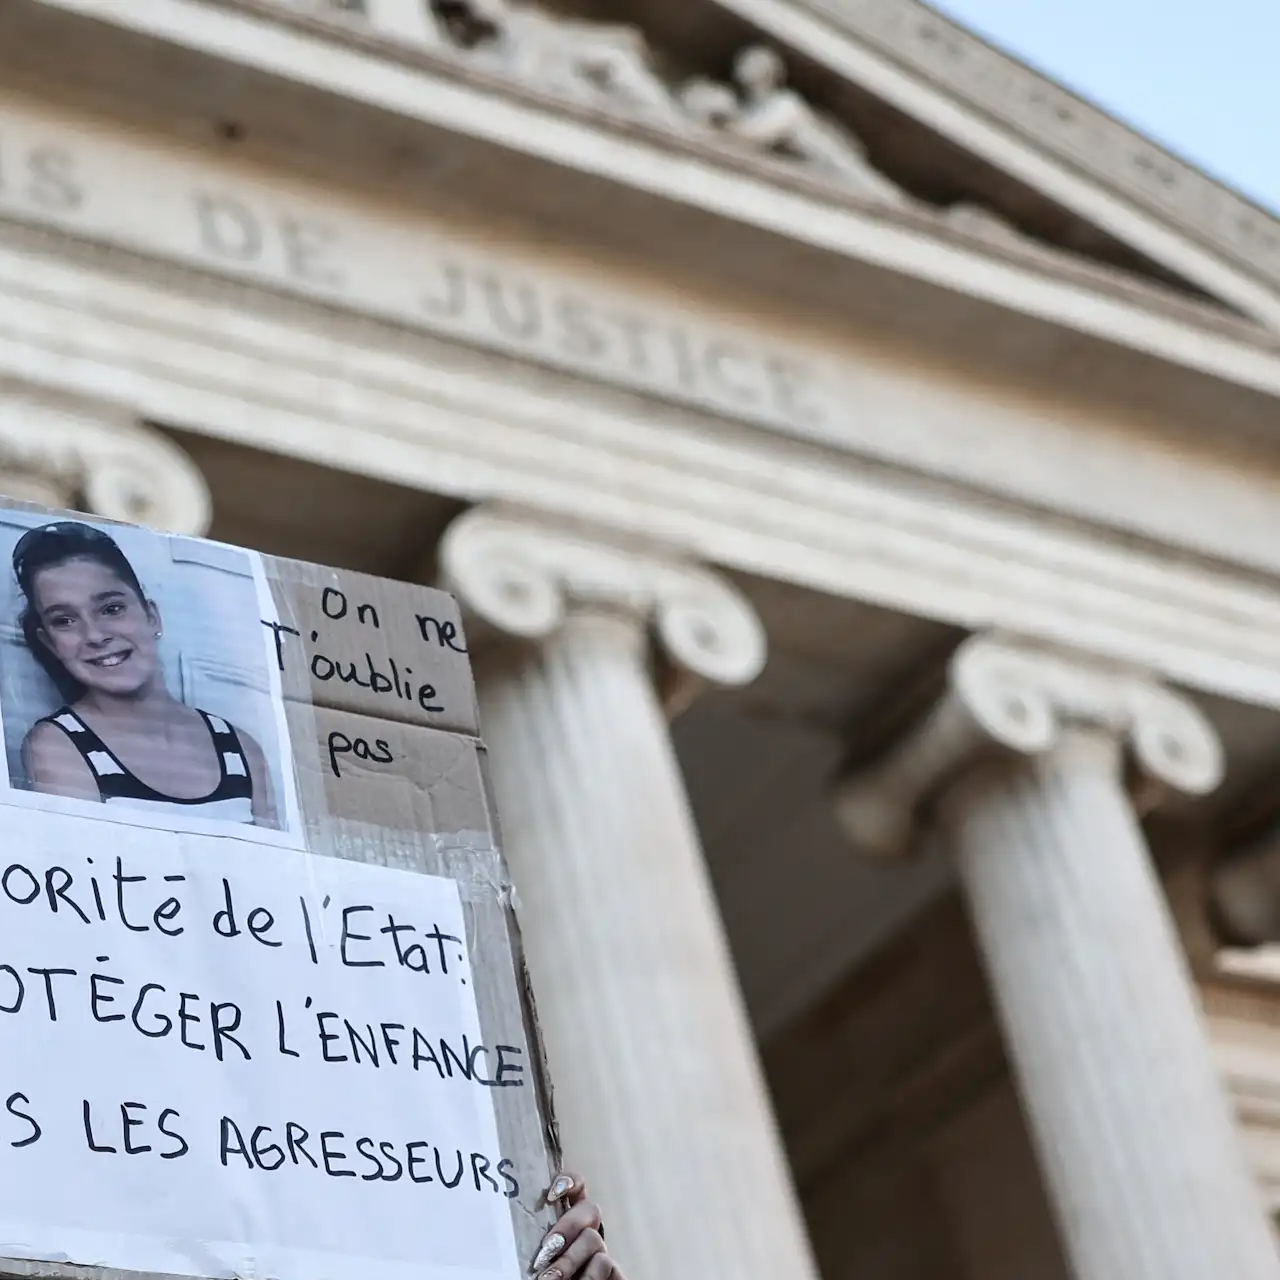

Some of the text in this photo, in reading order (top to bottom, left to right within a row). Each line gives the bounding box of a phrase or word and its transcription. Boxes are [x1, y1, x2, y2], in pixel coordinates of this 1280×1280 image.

[192, 192, 346, 294] DE
[422, 258, 826, 426] JUSTICE
[415, 613, 470, 654] ne
[328, 731, 394, 778] pas
[213, 878, 283, 947] de
[276, 996, 524, 1087] L'ENFANCE
[83, 1099, 189, 1159] LES
[220, 1115, 520, 1199] AGRESSEURS
